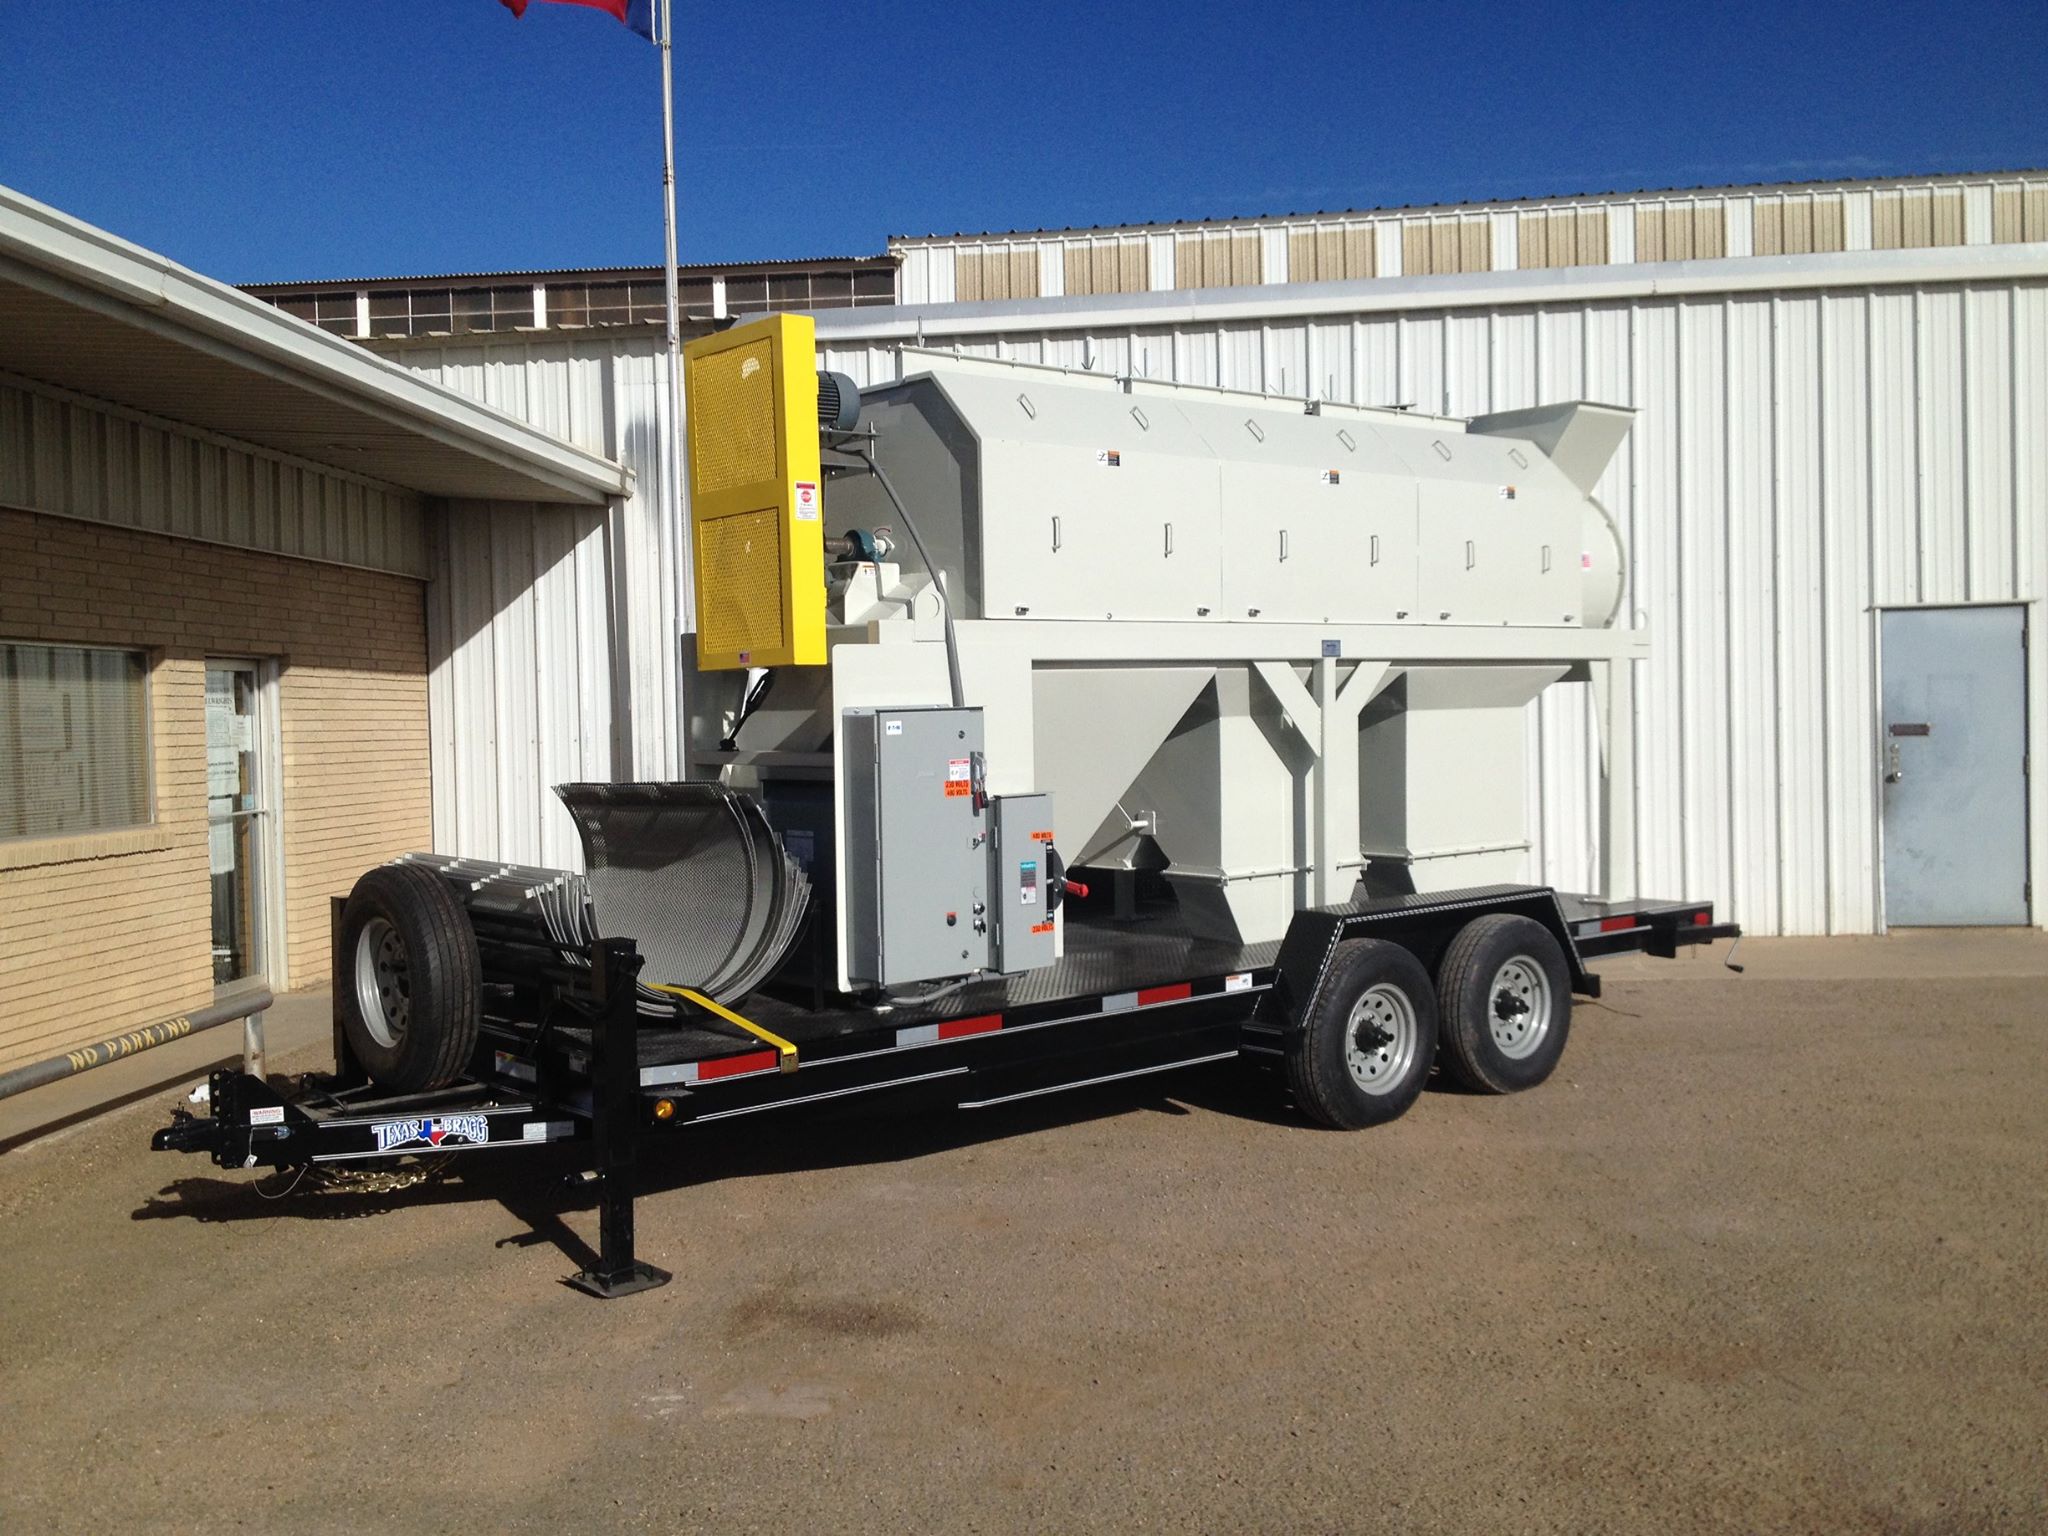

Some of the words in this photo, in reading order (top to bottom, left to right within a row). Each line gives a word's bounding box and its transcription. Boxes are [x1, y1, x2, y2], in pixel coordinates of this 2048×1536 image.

[67, 1047, 98, 1071] NO
[371, 1120, 420, 1151] TEXAS
[441, 1115, 489, 1144] BRAGG
